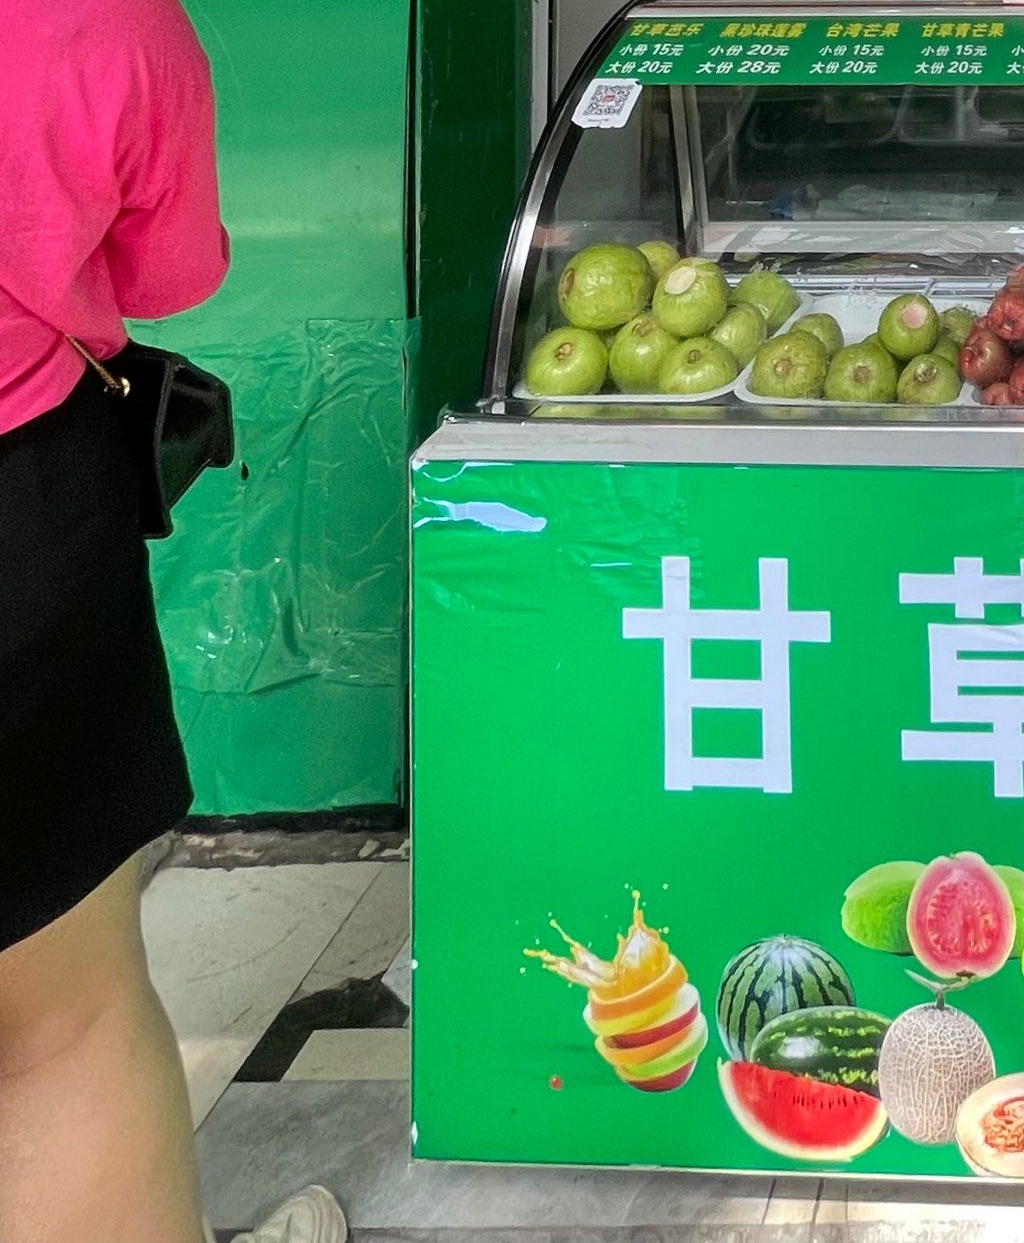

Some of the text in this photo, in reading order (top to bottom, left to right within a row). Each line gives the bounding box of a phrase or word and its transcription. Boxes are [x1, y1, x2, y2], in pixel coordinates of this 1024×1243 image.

[825, 22, 900, 37] 台湾芒果
[619, 44, 683, 56] 小份 15元
[708, 44, 789, 56] 小份 20元
[819, 45, 884, 56] 小份 15元
[921, 45, 987, 56] 小份 15元
[605, 61, 672, 73] 大份 20元
[696, 61, 780, 74] 大份 28元
[810, 61, 877, 73] 大份 20元
[915, 61, 982, 74] 大份 20元
